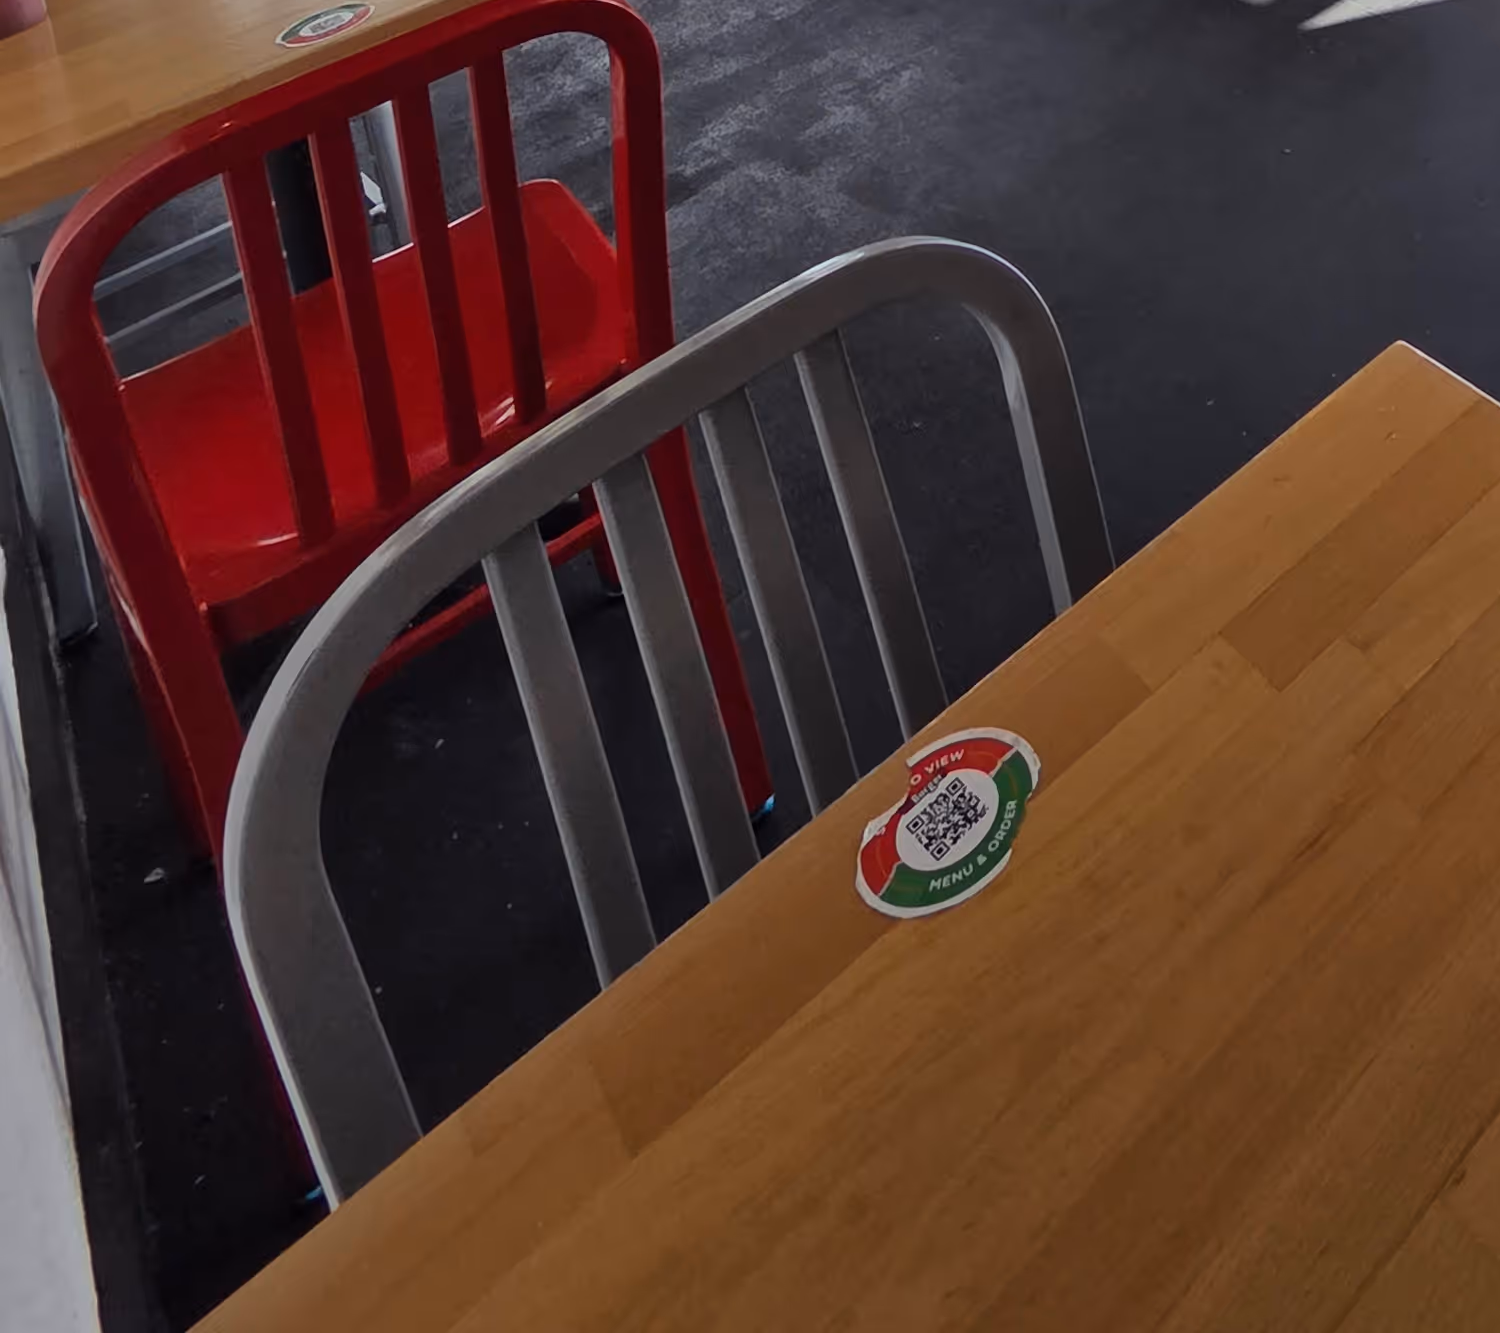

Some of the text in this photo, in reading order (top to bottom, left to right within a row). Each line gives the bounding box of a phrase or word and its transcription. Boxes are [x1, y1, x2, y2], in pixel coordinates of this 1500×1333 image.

[924, 748, 965, 774] VIEW
[928, 862, 974, 892] MENU
[987, 799, 1018, 853] ORDER
